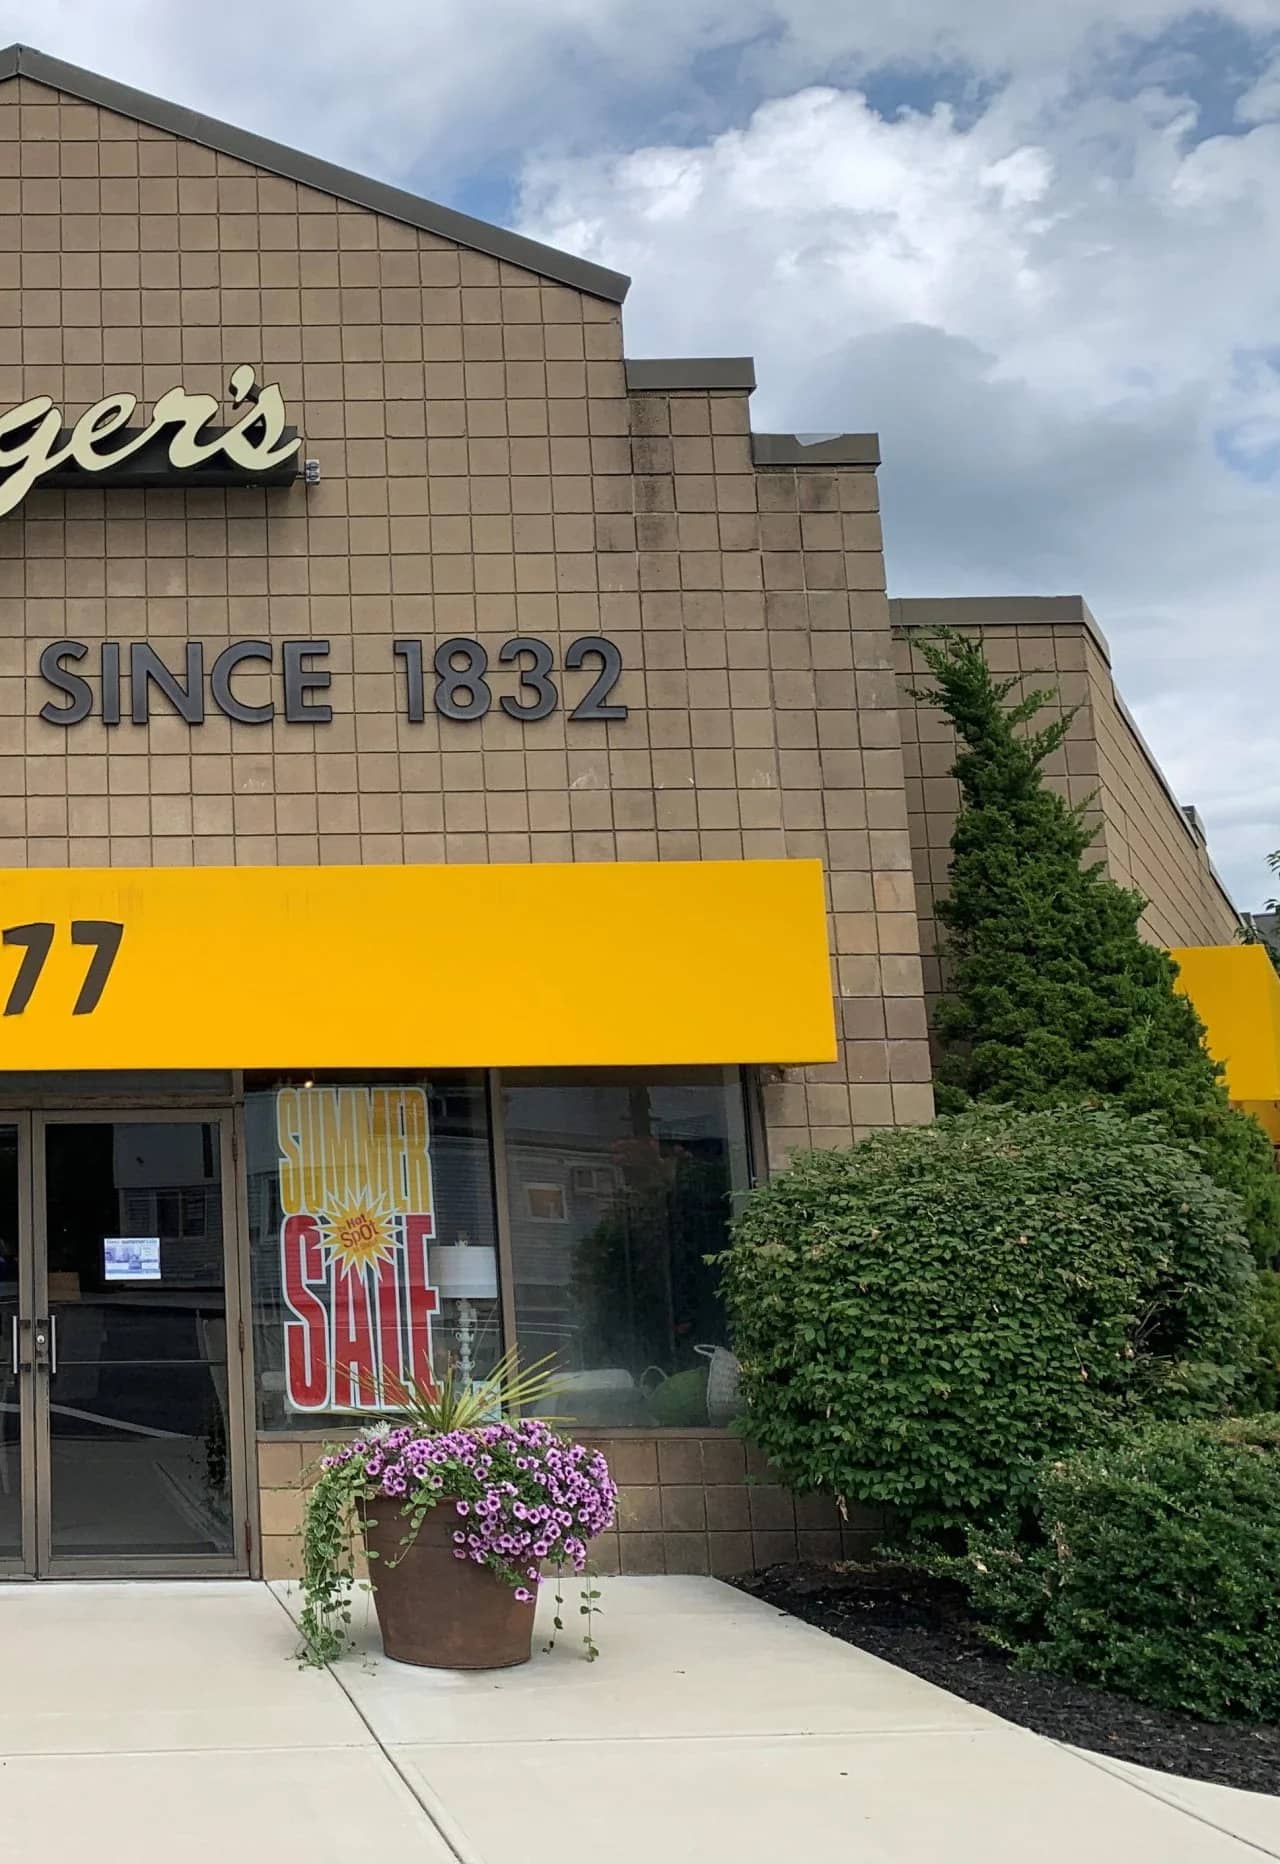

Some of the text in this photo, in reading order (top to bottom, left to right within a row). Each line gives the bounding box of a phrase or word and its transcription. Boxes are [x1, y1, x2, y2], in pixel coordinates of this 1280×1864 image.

[39, 639, 333, 725] SINCE
[393, 637, 629, 722] 1832
[276, 1087, 433, 1216] SUMMER
[346, 1213, 367, 1229] Hot
[281, 1213, 444, 1412] SALE
